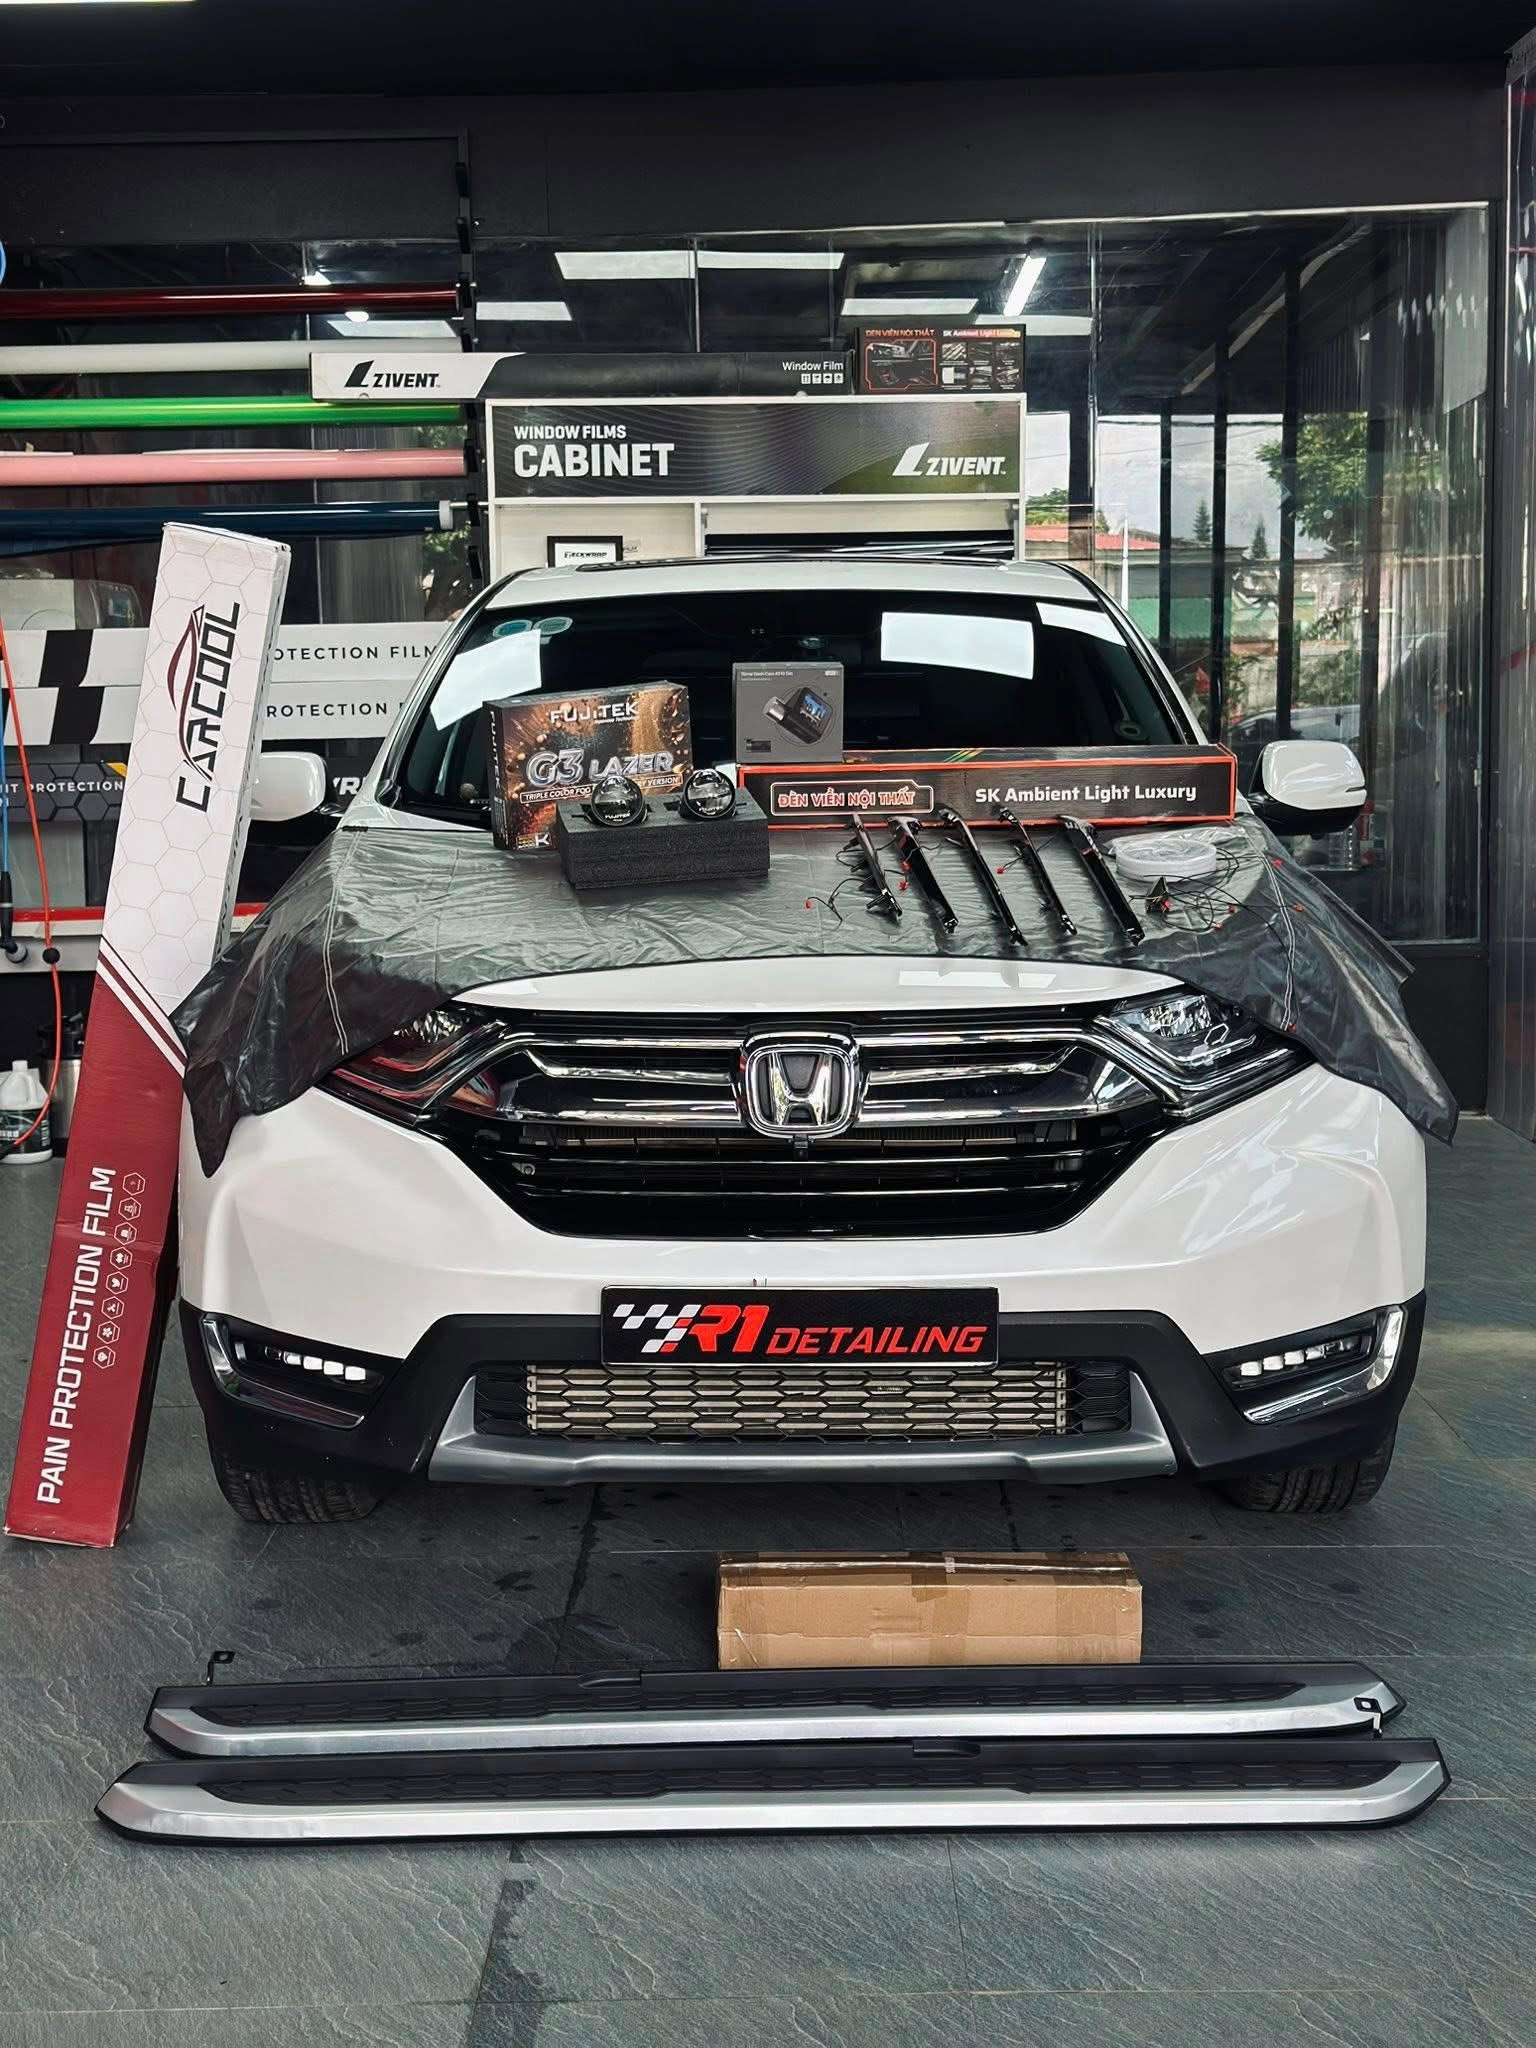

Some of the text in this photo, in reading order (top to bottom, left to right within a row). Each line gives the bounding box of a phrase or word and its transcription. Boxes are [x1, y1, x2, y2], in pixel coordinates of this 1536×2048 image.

[782, 361, 844, 371] Window Film
[373, 373, 439, 388] ZIVENT
[514, 425, 627, 439] WINDOW FILMS
[514, 443, 675, 478] CABINET
[926, 457, 1005, 476] ZIVENT
[274, 647, 379, 660] OTECTION
[176, 602, 240, 812] CARCOOL
[266, 703, 388, 717] ROTECTION
[550, 702, 639, 723] FUJITEK
[526, 749, 673, 788] G3 LAZER
[524, 792, 549, 801] TRIPLE
[549, 789, 575, 798] COLOR
[778, 785, 916, 809] ĐÈN VIỀN NỘI THẤT
[975, 784, 1197, 803] SK Ambient Light Luxury
[37, 1167, 116, 1503] PAIN PROTECTION FILM
[689, 1305, 989, 1355] R1 DETAILING
